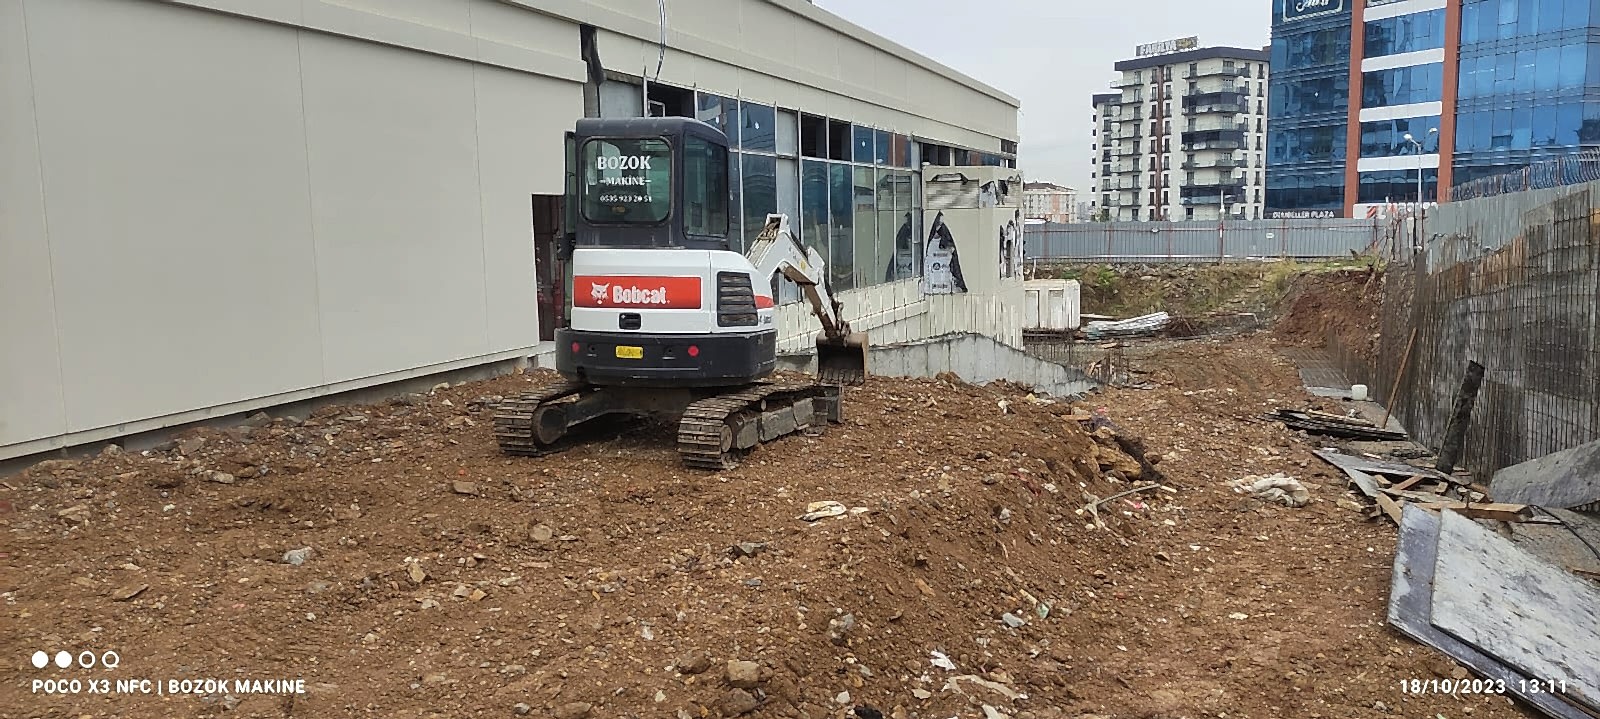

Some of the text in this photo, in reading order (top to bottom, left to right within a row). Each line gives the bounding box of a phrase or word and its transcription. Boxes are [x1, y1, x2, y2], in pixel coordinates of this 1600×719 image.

[598, 155, 652, 170] BOZOK
[1311, 210, 1335, 219] PLAZA
[613, 285, 667, 305] Bobcat
